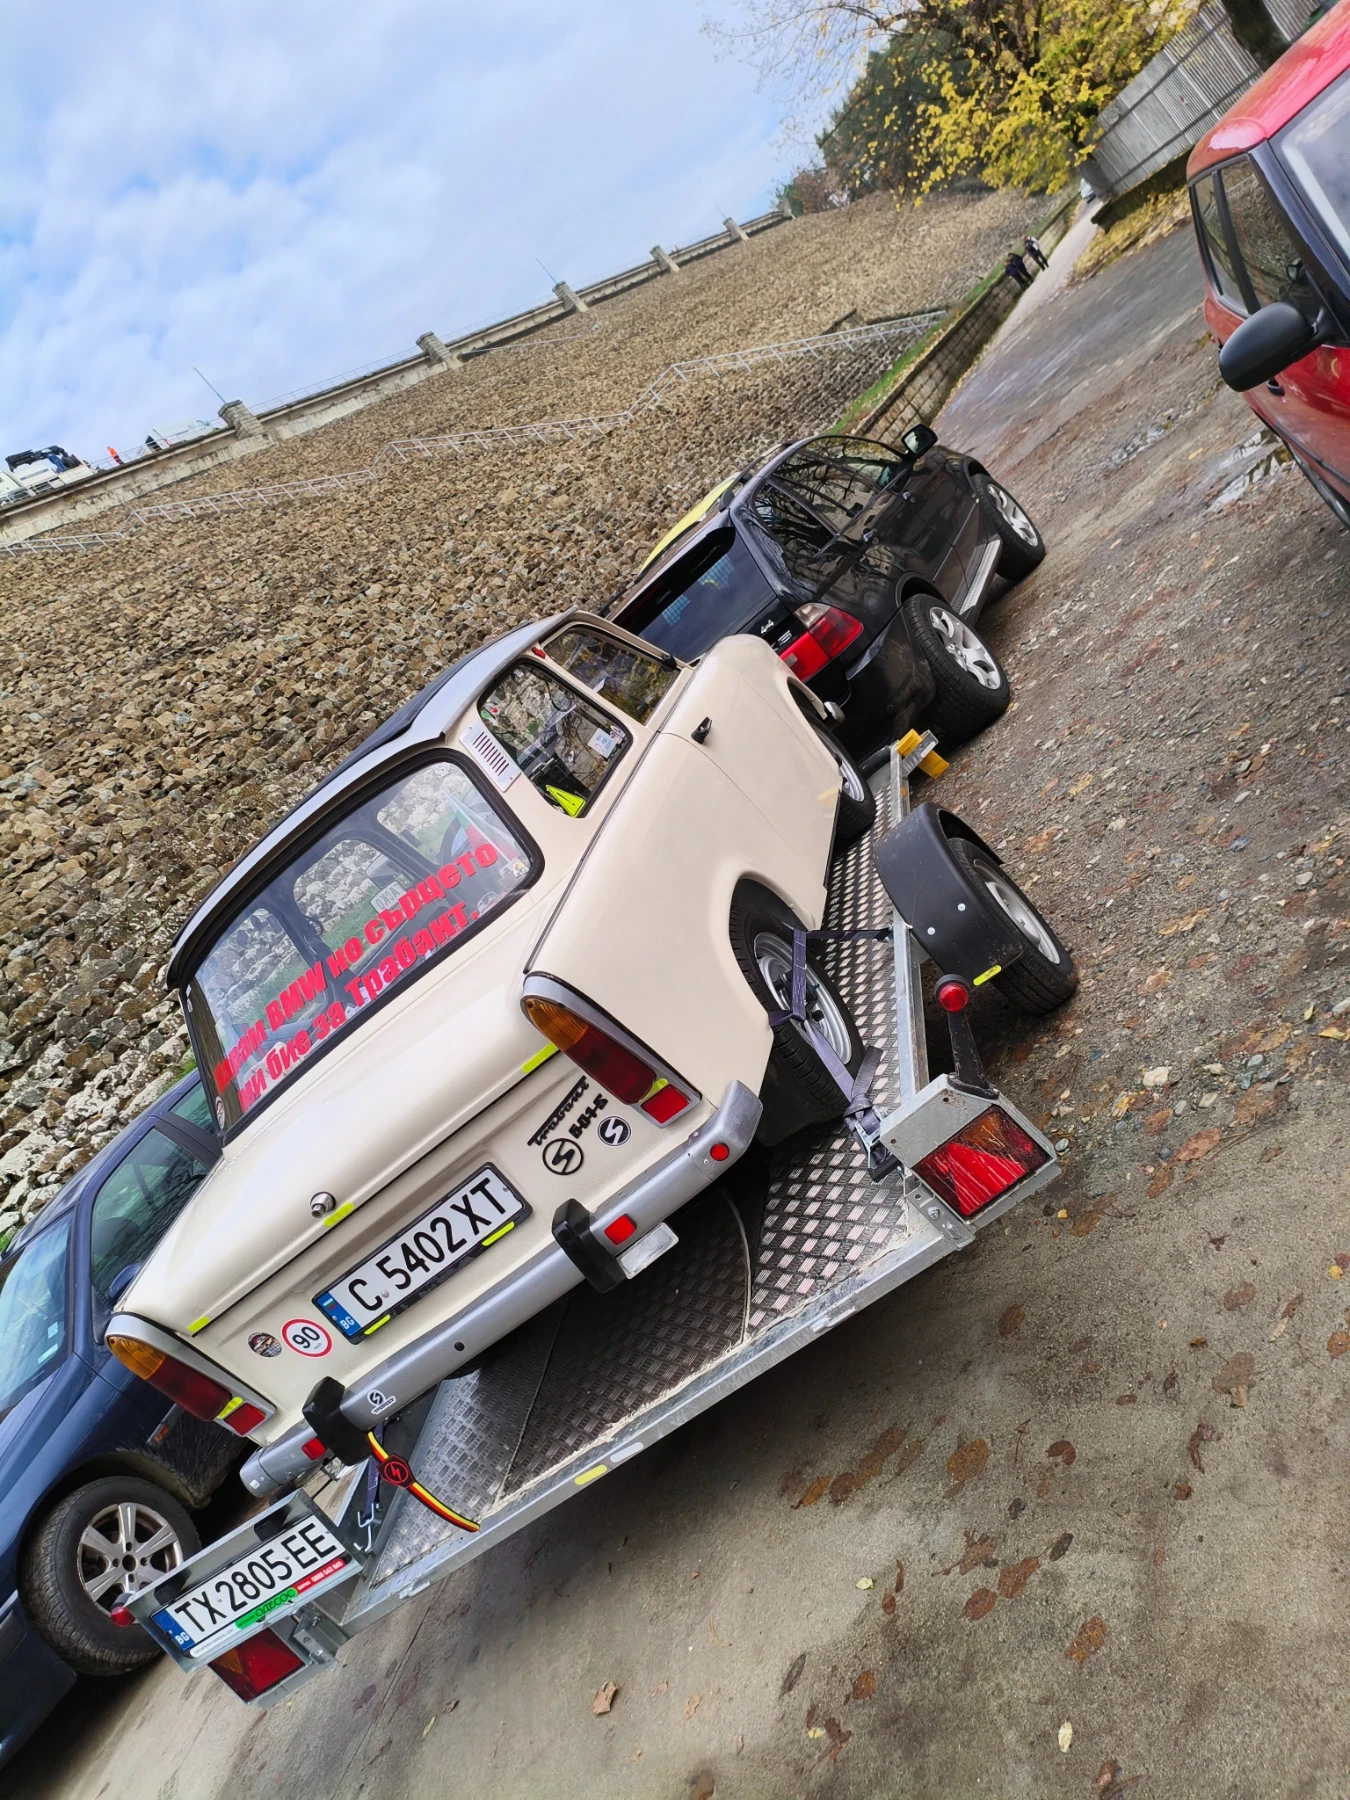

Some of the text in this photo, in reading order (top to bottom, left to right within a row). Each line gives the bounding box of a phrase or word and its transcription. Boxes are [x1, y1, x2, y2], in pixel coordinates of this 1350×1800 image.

[266, 961, 327, 1032] BMW
[328, 936, 363, 977] но
[364, 843, 497, 945] сърцето
[238, 1069, 266, 1112] ми
[266, 1028, 311, 1082] бие
[312, 1001, 348, 1041] за
[339, 1315, 355, 1331] BG
[291, 1325, 320, 1349] 90
[174, 1631, 191, 1646] BG
